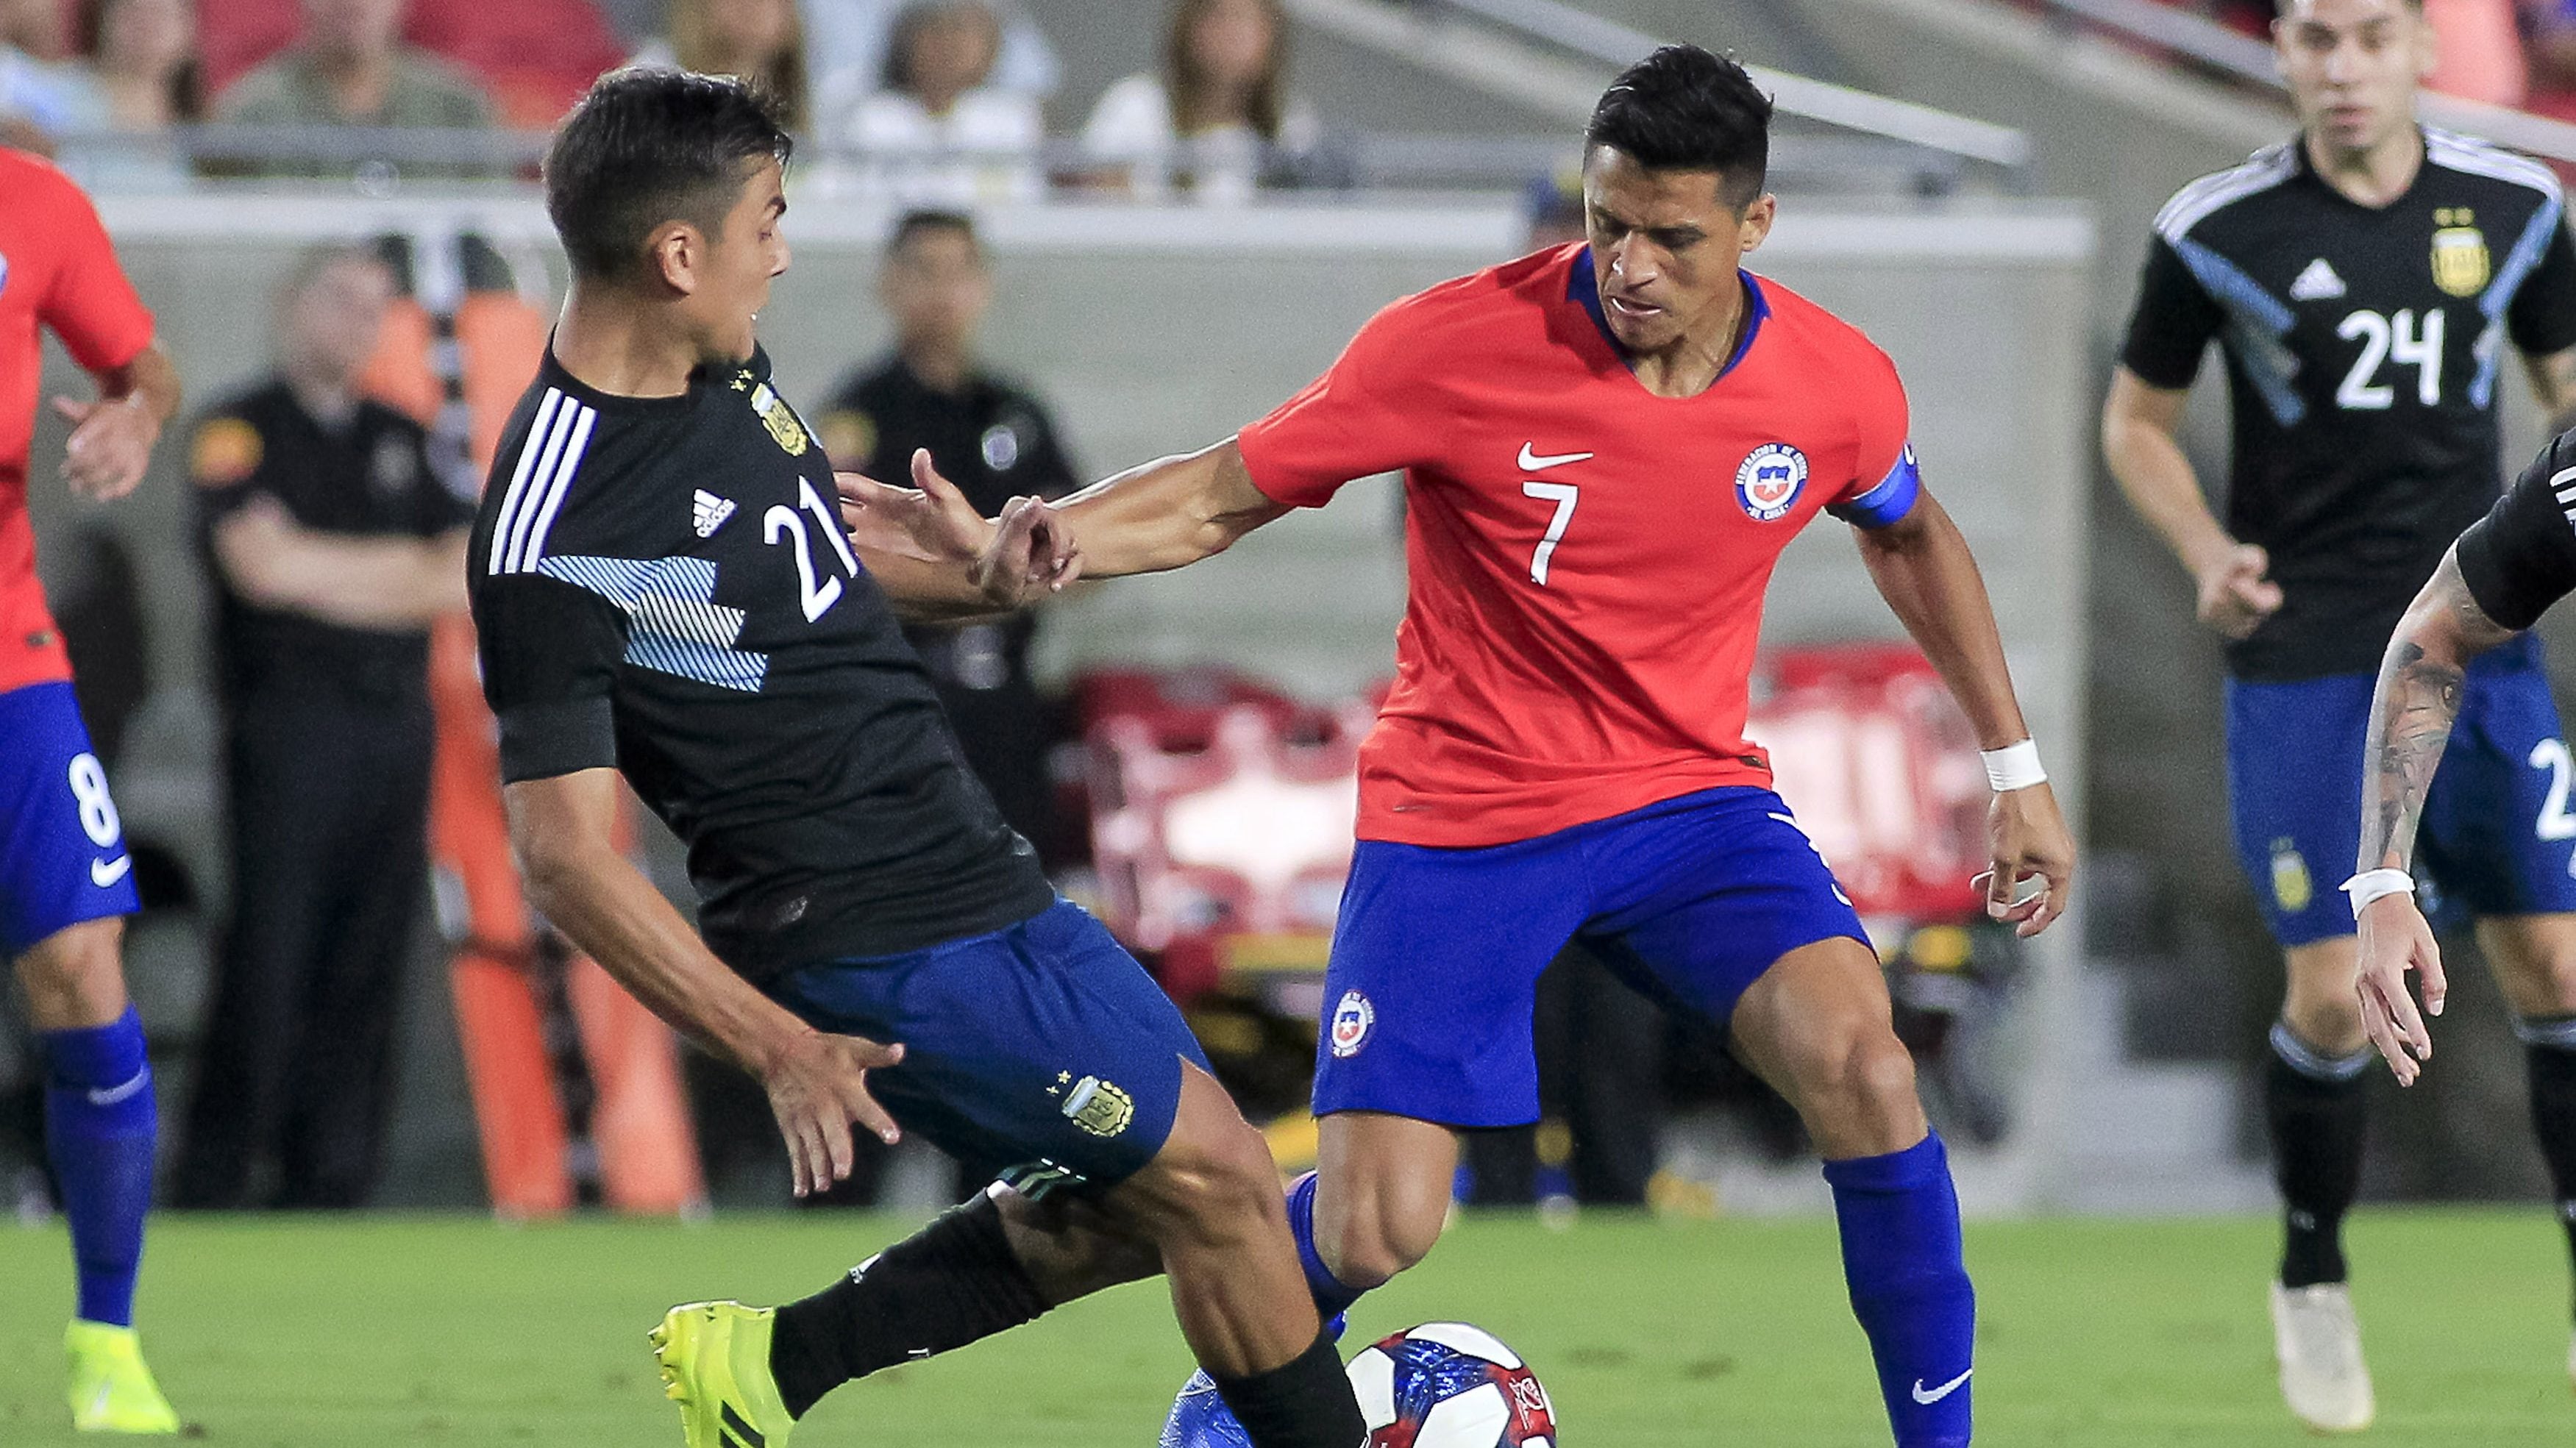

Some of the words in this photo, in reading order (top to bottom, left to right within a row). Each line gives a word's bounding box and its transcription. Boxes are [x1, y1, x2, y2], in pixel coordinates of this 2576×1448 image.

[2337, 308, 2444, 409] 24
[764, 475, 858, 624] 21
[1522, 482, 1579, 586] 7
[68, 752, 121, 848] 8
[2528, 738, 2576, 841] 2
